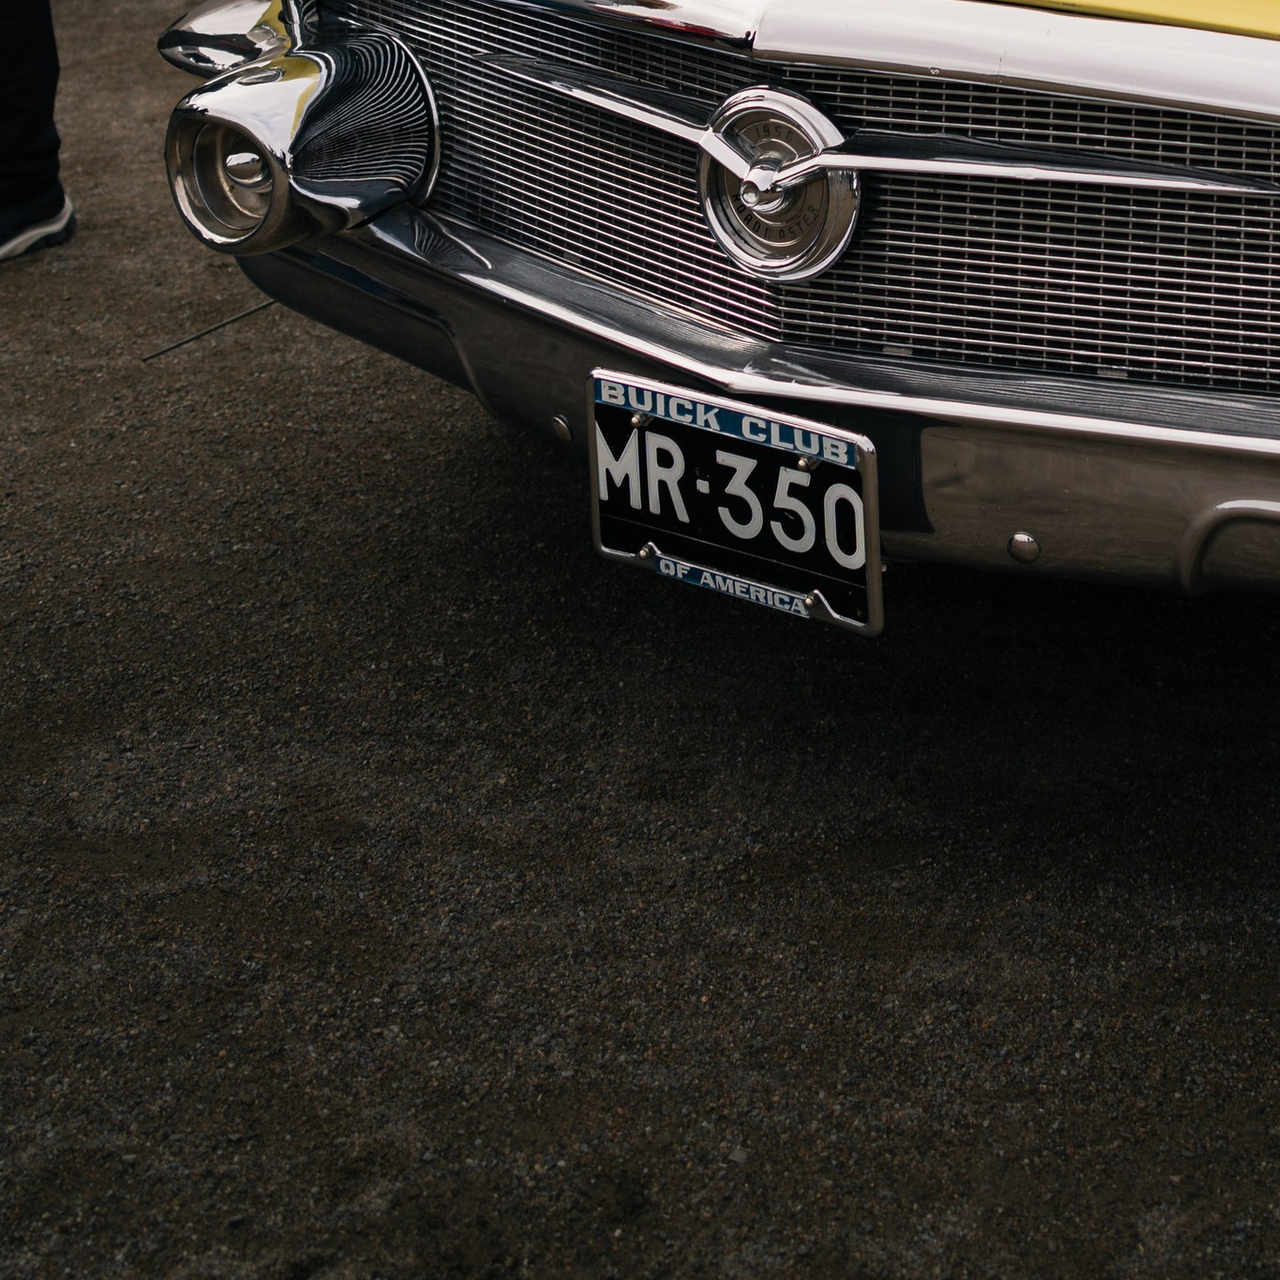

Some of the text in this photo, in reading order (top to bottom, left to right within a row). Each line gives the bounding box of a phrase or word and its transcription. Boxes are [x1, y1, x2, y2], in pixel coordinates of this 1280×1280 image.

[755, 124, 795, 142] 1956
[731, 193, 820, 241] ROADMASTER
[600, 380, 850, 465] BUICK CLUB
[595, 421, 867, 571] MR-350
[659, 558, 810, 616] OF AMERICA
